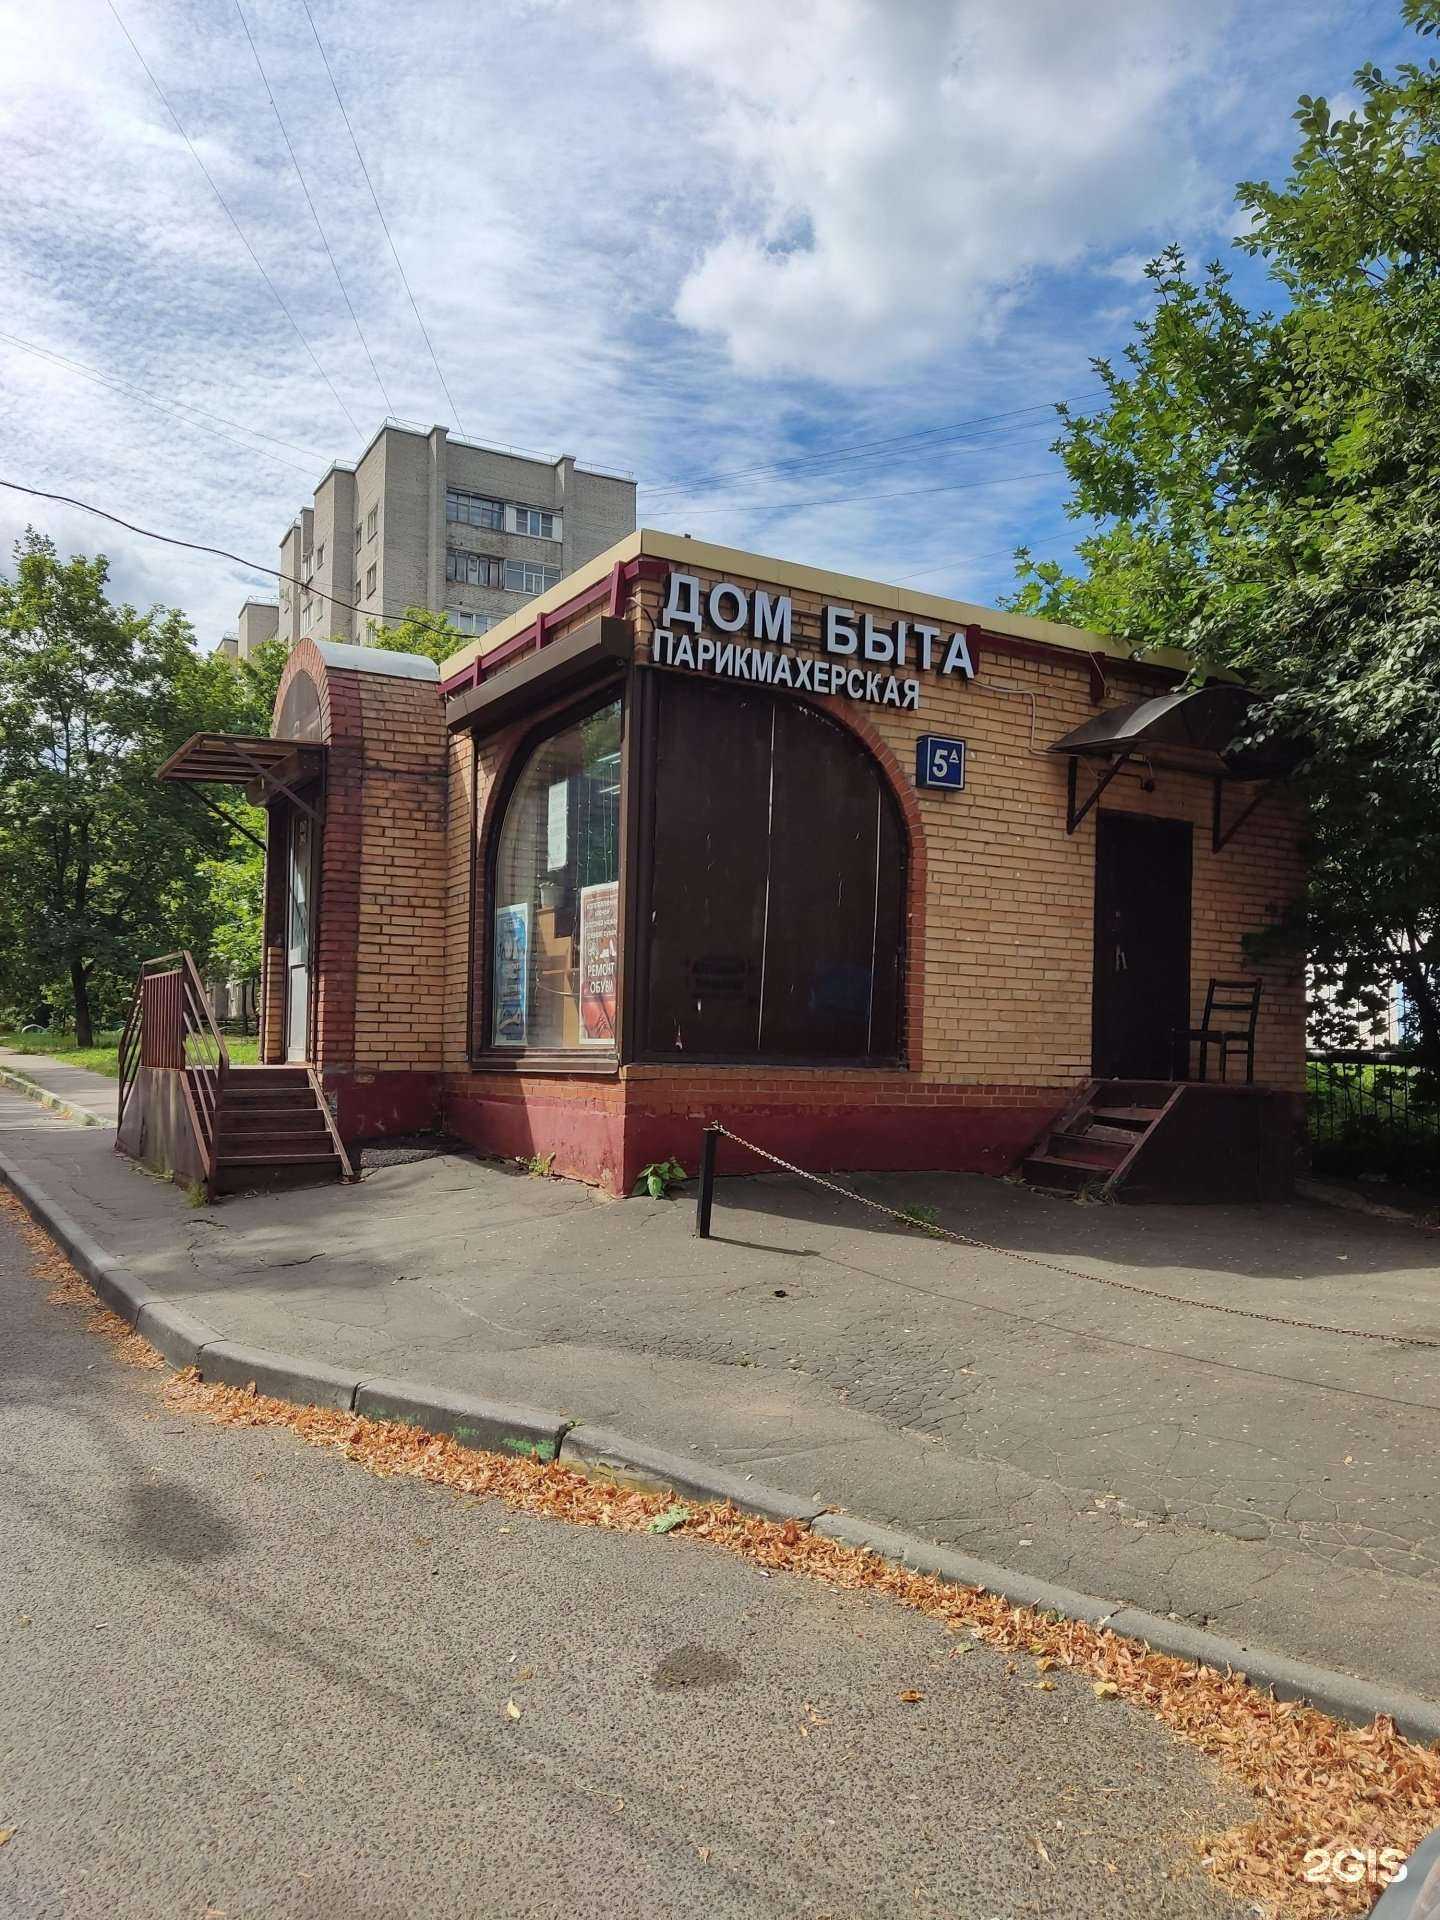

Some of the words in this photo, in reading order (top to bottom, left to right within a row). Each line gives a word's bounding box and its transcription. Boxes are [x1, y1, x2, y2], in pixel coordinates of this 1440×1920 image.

[662, 572, 792, 644] ДОМ
[826, 604, 975, 680] БЫТА
[652, 628, 920, 710] ПАРИКМАХЕРСКАЯ
[587, 962, 615, 977] РЕМОНТ
[590, 980, 615, 994] ОБУВИ
